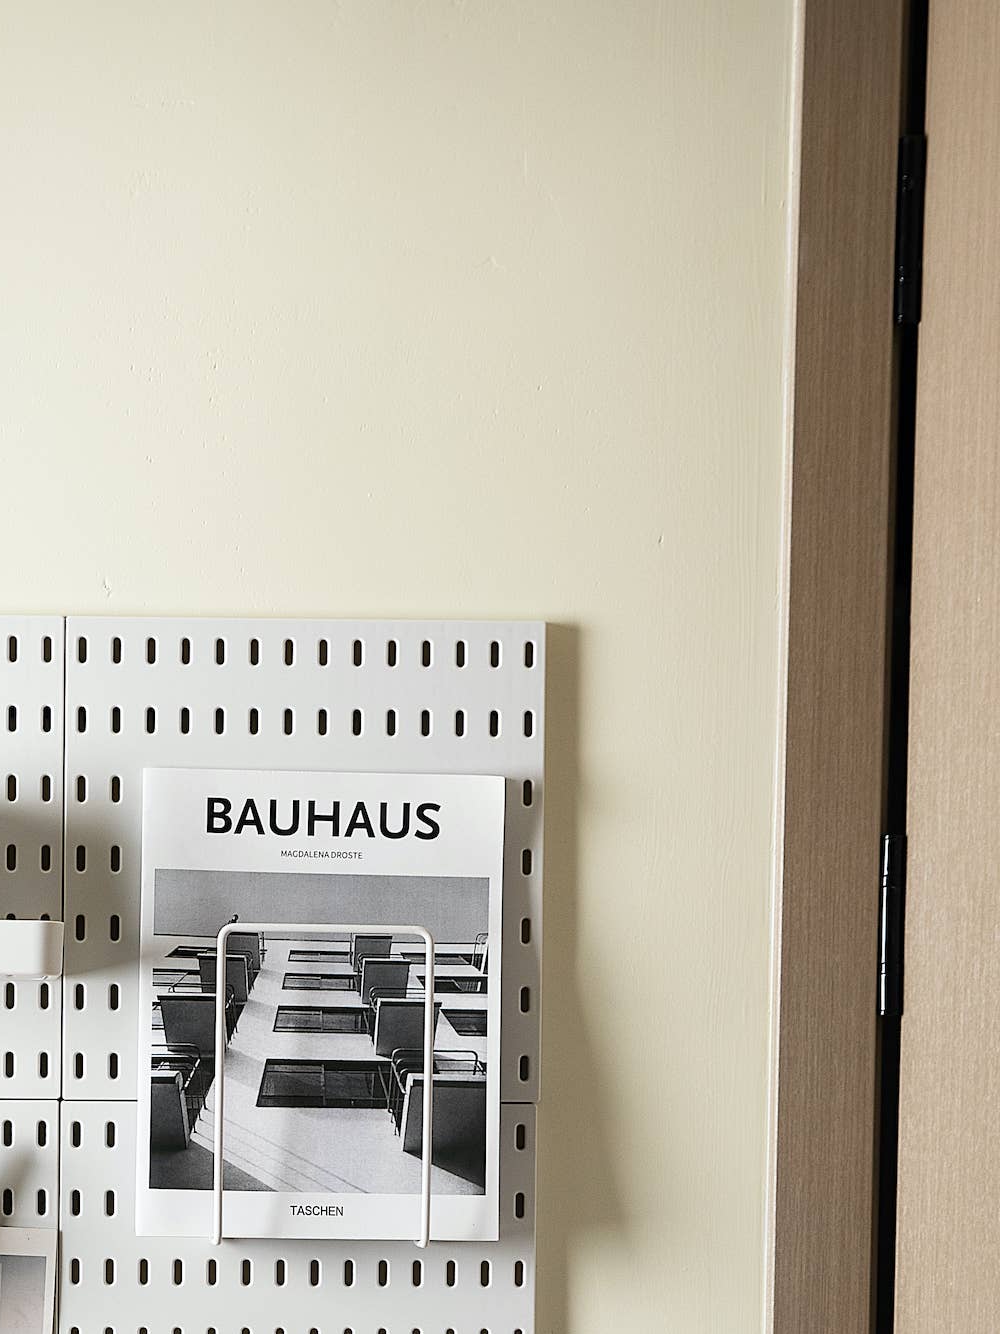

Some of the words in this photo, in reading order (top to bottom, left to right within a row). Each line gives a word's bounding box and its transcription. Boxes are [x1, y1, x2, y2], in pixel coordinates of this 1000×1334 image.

[205, 797, 441, 841] BAUHAUS
[280, 850, 329, 859] MAGDALENA
[330, 851, 363, 860] DROSTE
[289, 1205, 344, 1217] TASCHEN
